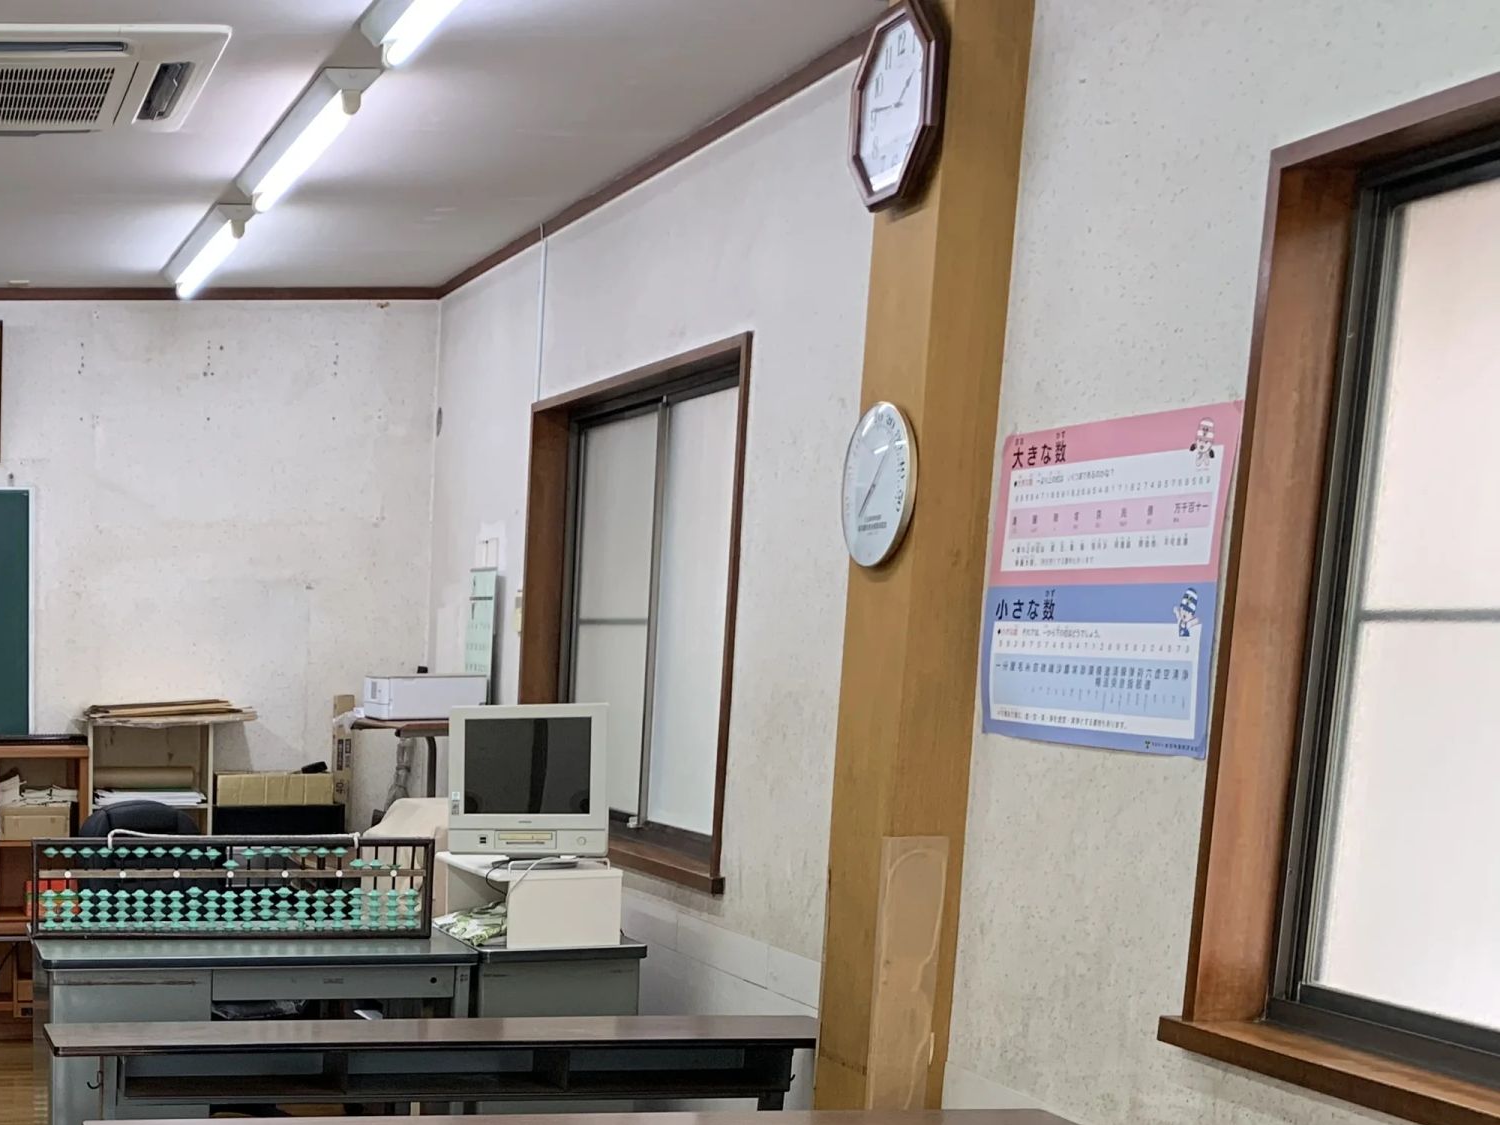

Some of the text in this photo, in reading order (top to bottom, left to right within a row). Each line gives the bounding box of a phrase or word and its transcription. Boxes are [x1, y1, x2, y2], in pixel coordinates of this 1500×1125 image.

[1011, 440, 1067, 469] 大きな数
[995, 599, 1056, 621] 小さな数
